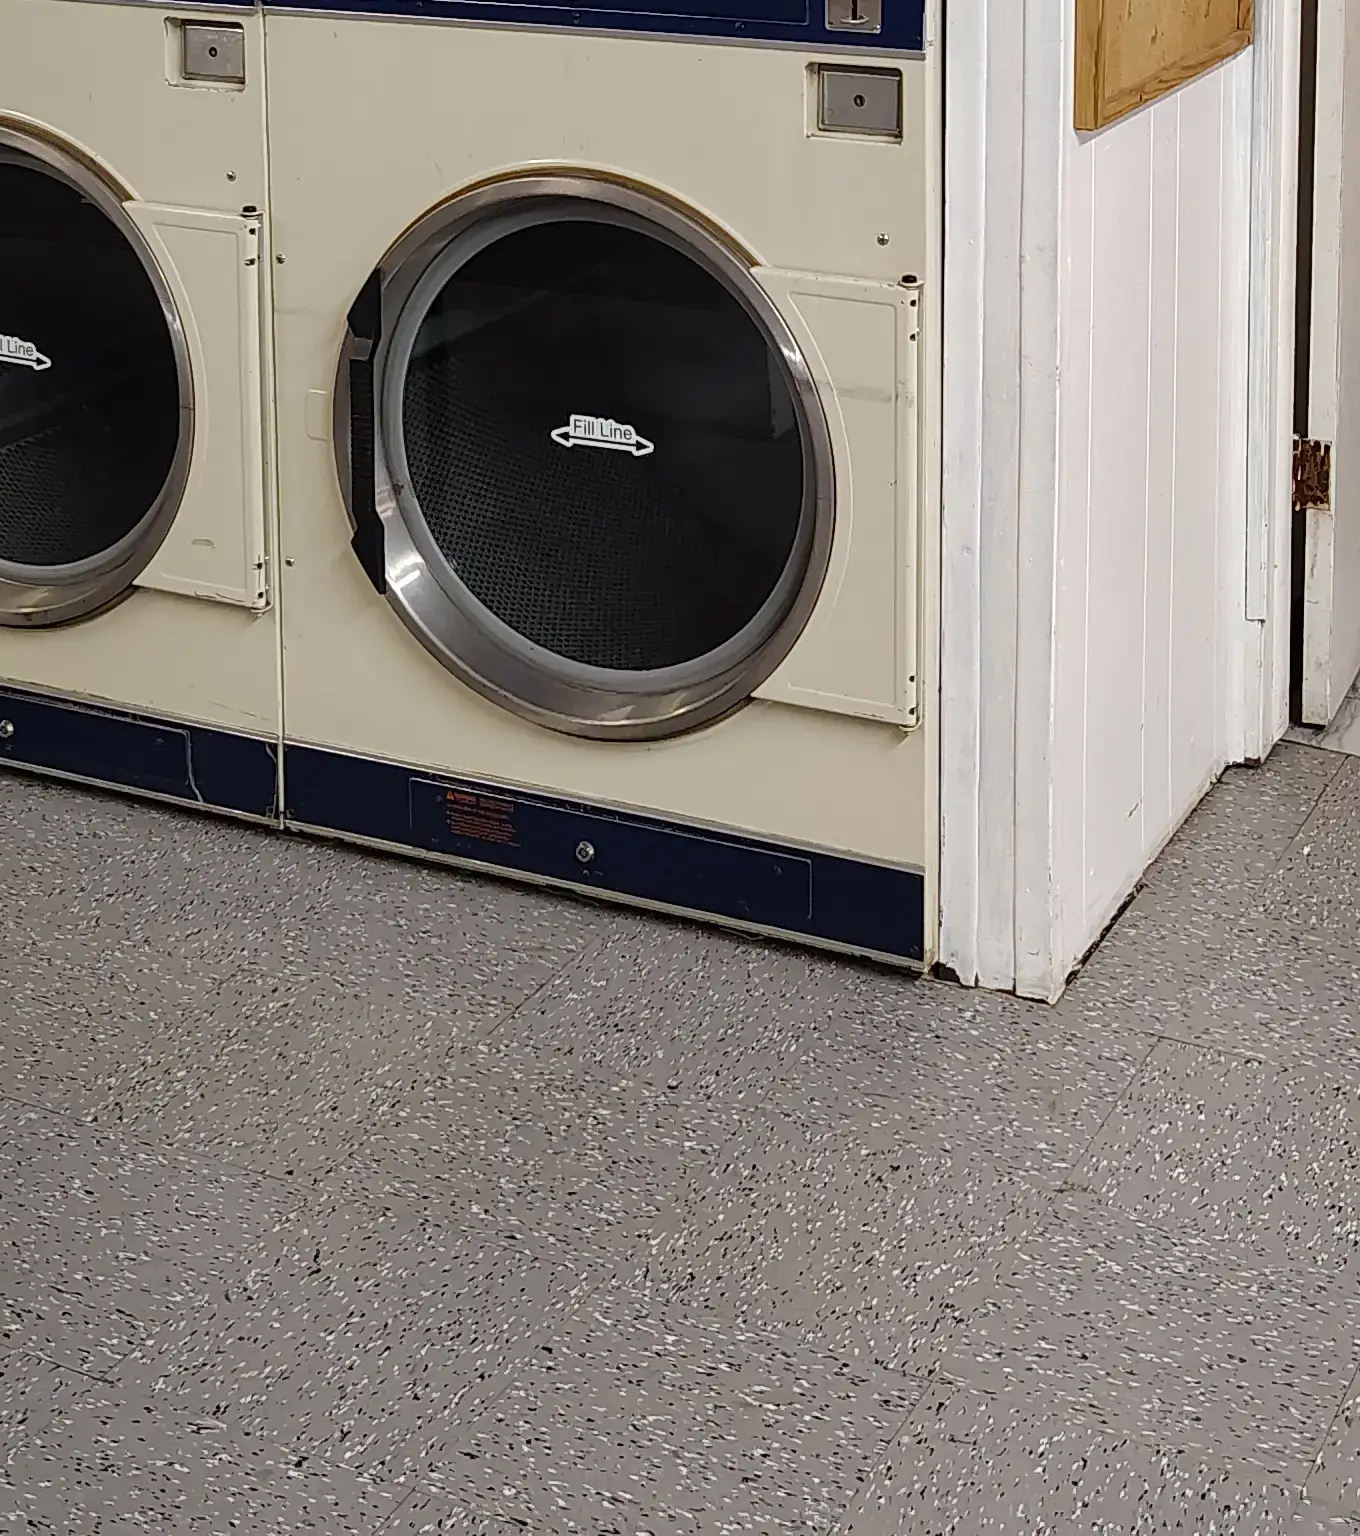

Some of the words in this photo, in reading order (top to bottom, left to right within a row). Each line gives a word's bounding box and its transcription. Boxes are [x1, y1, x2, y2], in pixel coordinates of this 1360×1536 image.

[7, 338, 35, 357] Line
[573, 417, 597, 436] Fill
[600, 419, 632, 441] Line
